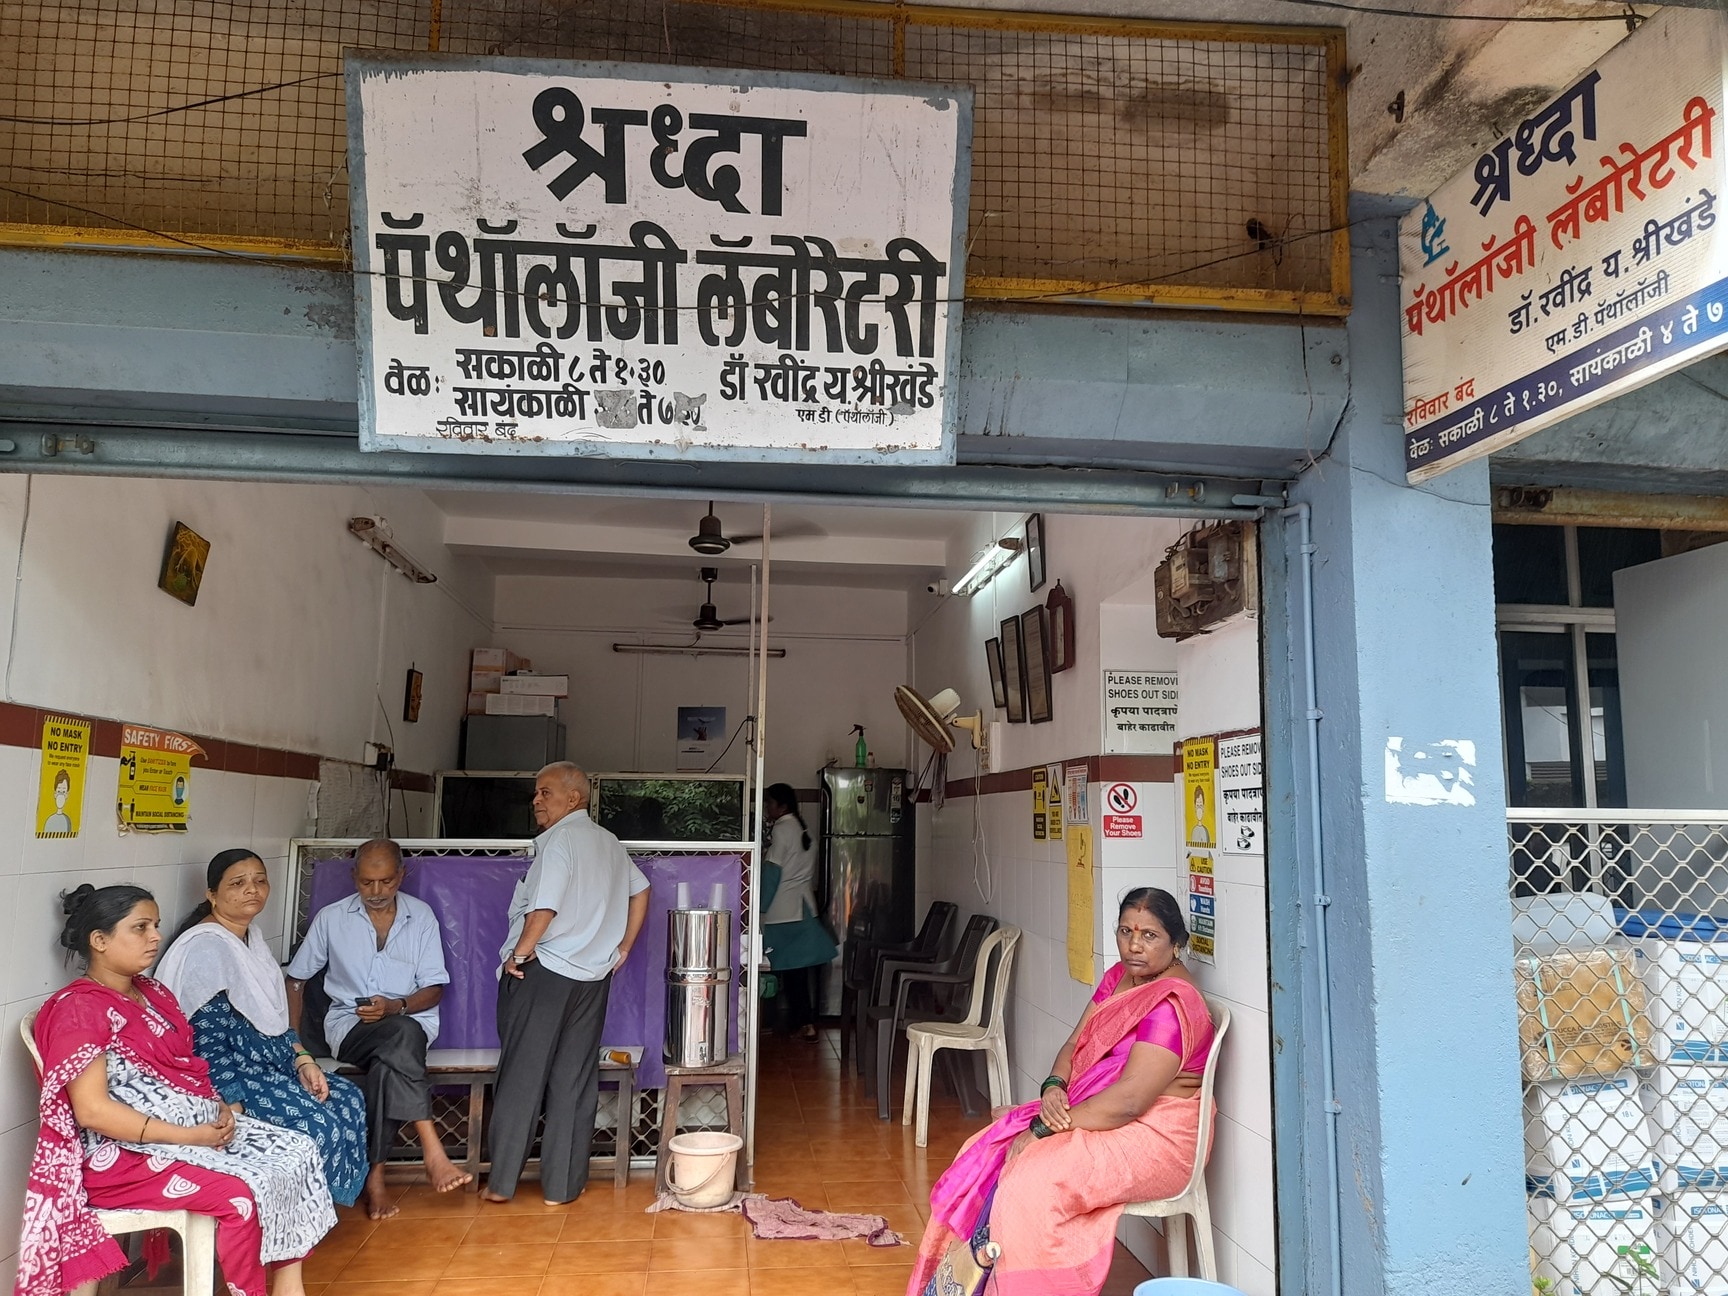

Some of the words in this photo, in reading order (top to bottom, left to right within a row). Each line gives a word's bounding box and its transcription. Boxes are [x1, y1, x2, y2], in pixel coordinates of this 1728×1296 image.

[523, 86, 807, 216] श्रध्दा
[1470, 70, 1602, 217] श्रध्दा
[1405, 215, 1537, 336] पॅथॉलॉजी
[1546, 95, 1717, 251] लॅबोरेटरी
[376, 211, 687, 345] पॅथॉलॉजी
[696, 235, 946, 358] लॅबोरेटरी
[455, 342, 565, 382] सकाळी
[569, 355, 585, 382] ८
[589, 348, 612, 384] ते
[753, 353, 821, 404] रवींद्र
[1438, 407, 1484, 448] सकाळी
[1489, 405, 1499, 424] ८
[1503, 392, 1515, 416] ते
[1569, 326, 1653, 387] सायंकाळी
[1660, 320, 1674, 345] ४
[1682, 304, 1699, 335] ते
[1706, 301, 1724, 323] ७
[453, 382, 590, 421] सायंकाळी
[637, 389, 657, 425] ते
[1406, 391, 1450, 427] रविवार
[1455, 376, 1475, 402] बंद
[1108, 676, 1142, 685] PLEASE
[1108, 689, 1139, 698] SHOES
[1141, 690, 1159, 699] OUT
[1111, 707, 1140, 718] कृपया
[51, 727, 61, 737] NO
[63, 729, 82, 739] MASK
[1116, 720, 1137, 731] बाहेर
[1138, 721, 1175, 732] काढावीत
[48, 741, 58, 750] NO
[60, 742, 83, 753] ENTRY
[124, 728, 160, 748] SAFETY
[164, 735, 199, 753] FIRST
[1195, 748, 1208, 756] MASK
[1221, 744, 1240, 758] PLEASE
[1242, 742, 1261, 756] REMOV
[1186, 762, 1194, 770] NO
[1194, 760, 1210, 770] ENTRY
[1222, 765, 1240, 778] SHOES
[1240, 763, 1252, 776] OUT
[1252, 762, 1262, 776] SID
[1223, 789, 1240, 804] कृपया
[1112, 816, 1134, 824] Please
[1227, 808, 1238, 824] बाहेर
[1197, 866, 1212, 874] CAUTION
